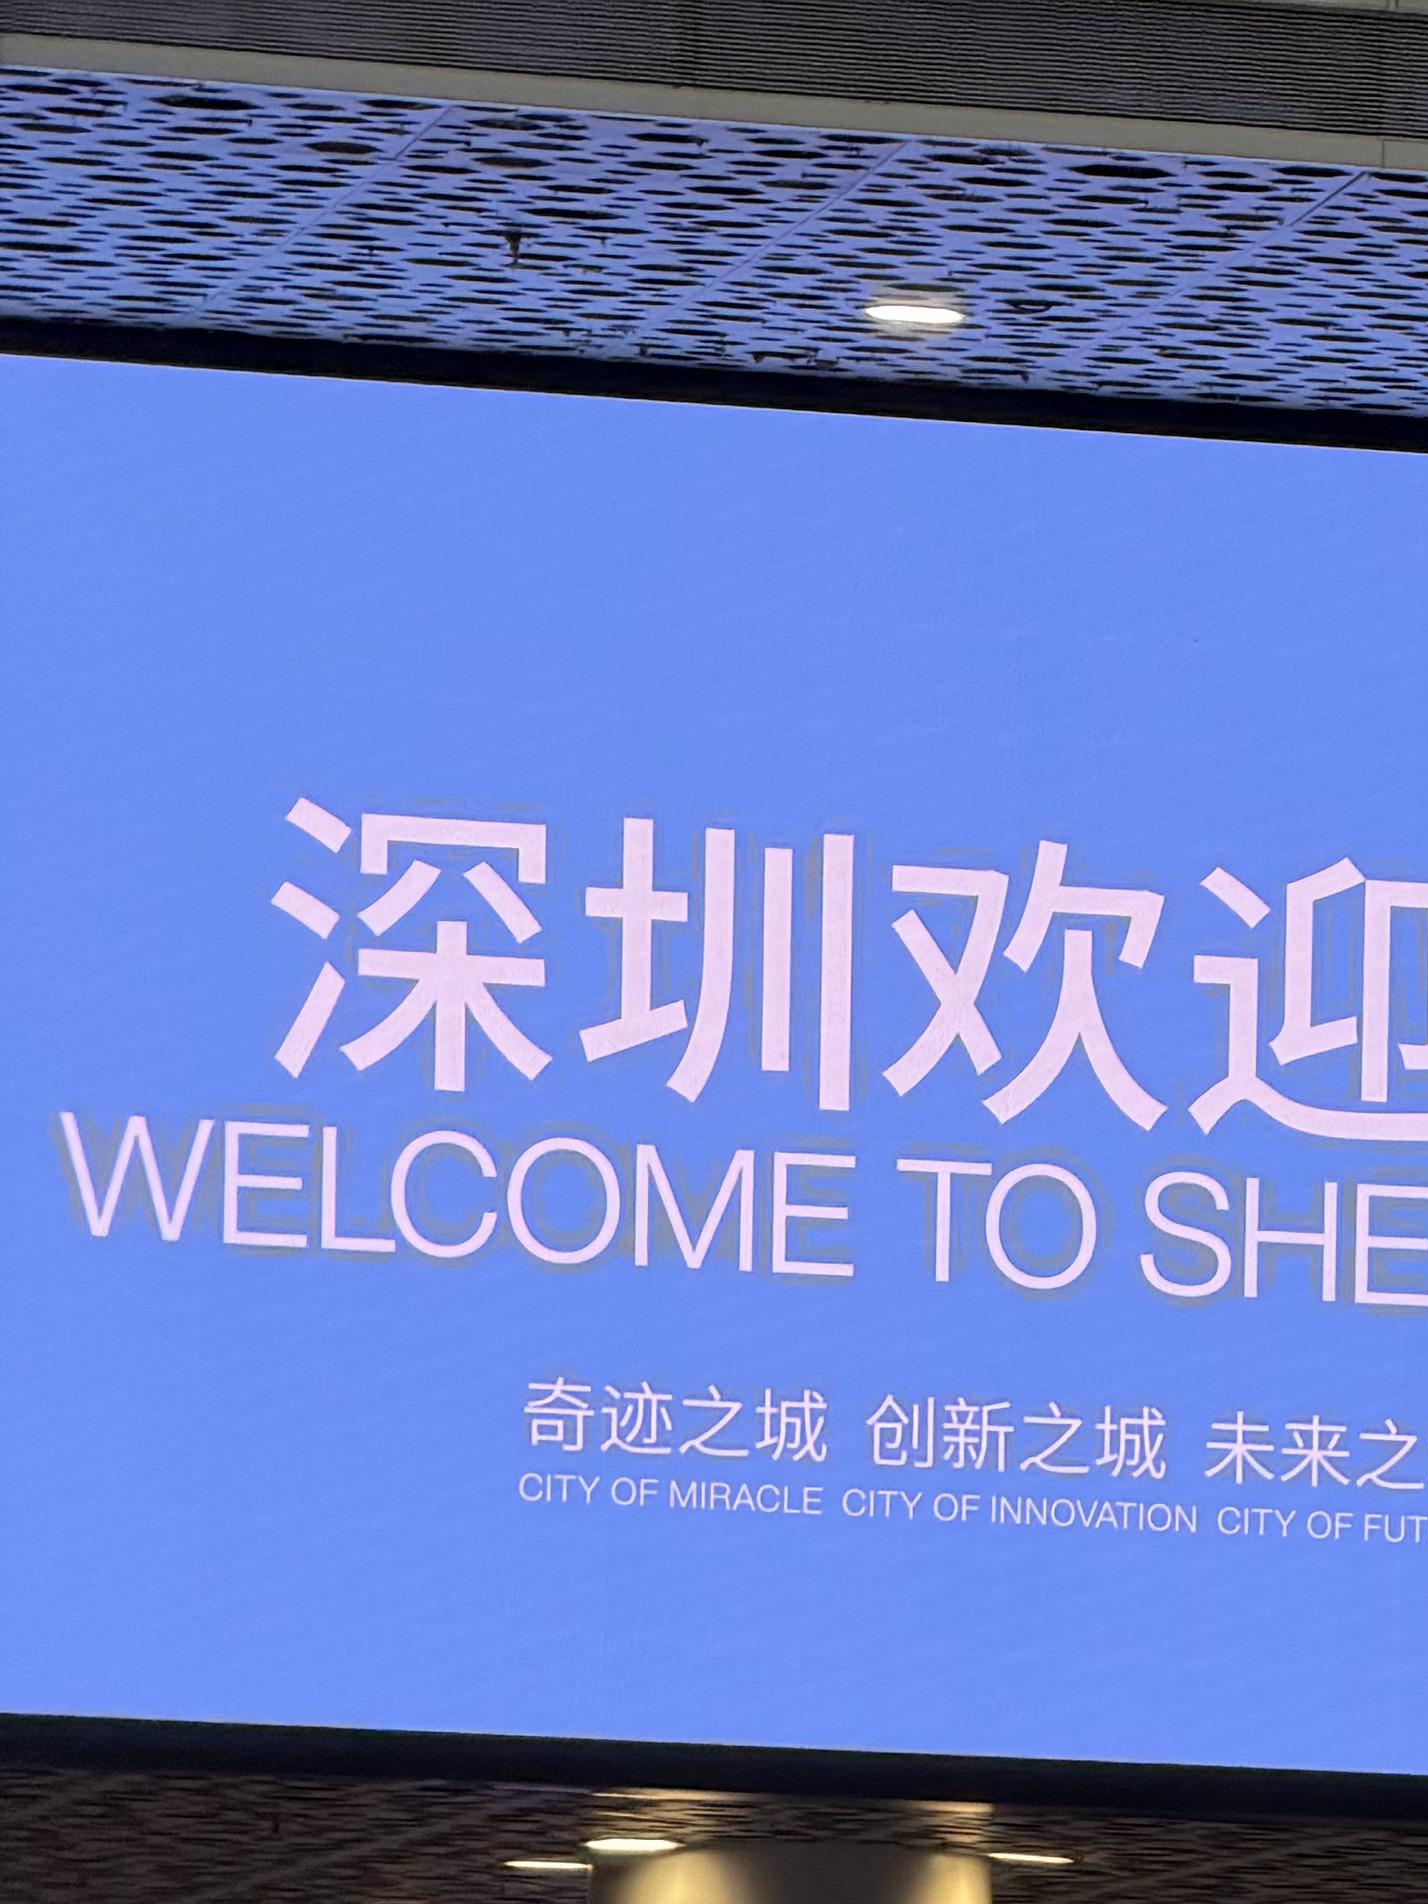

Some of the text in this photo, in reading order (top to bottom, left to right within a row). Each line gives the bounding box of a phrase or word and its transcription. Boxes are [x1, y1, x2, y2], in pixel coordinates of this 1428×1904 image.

[60, 1111, 857, 1277] WELCOME
[896, 1158, 1097, 1290] TO
[523, 1376, 828, 1463] 奇迹之城
[865, 1394, 1167, 1480] 创新之城
[518, 1472, 600, 1505] CITY
[610, 1476, 659, 1507] OF
[669, 1479, 824, 1515] MIRACLE
[841, 1487, 923, 1521] CITY
[932, 1492, 981, 1522] OF
[990, 1495, 1197, 1534] INNOVATION
[1216, 1506, 1297, 1538] CITY
[1306, 1510, 1355, 1540] OF
